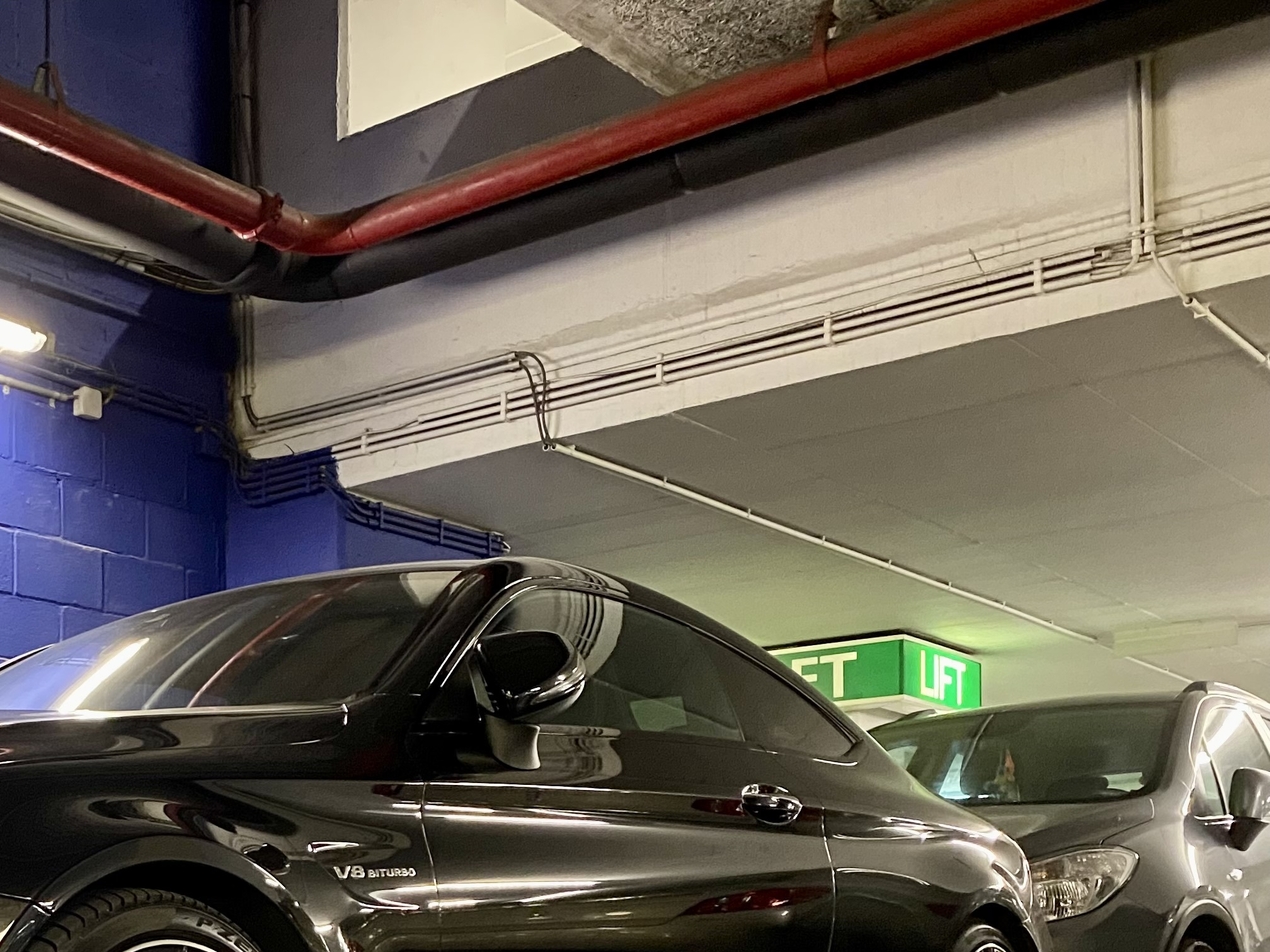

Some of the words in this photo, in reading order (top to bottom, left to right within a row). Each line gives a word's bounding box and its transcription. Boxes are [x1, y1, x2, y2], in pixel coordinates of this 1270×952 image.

[920, 650, 966, 705] LIFT
[333, 865, 366, 879] V8
[367, 868, 417, 878] BITURBO
